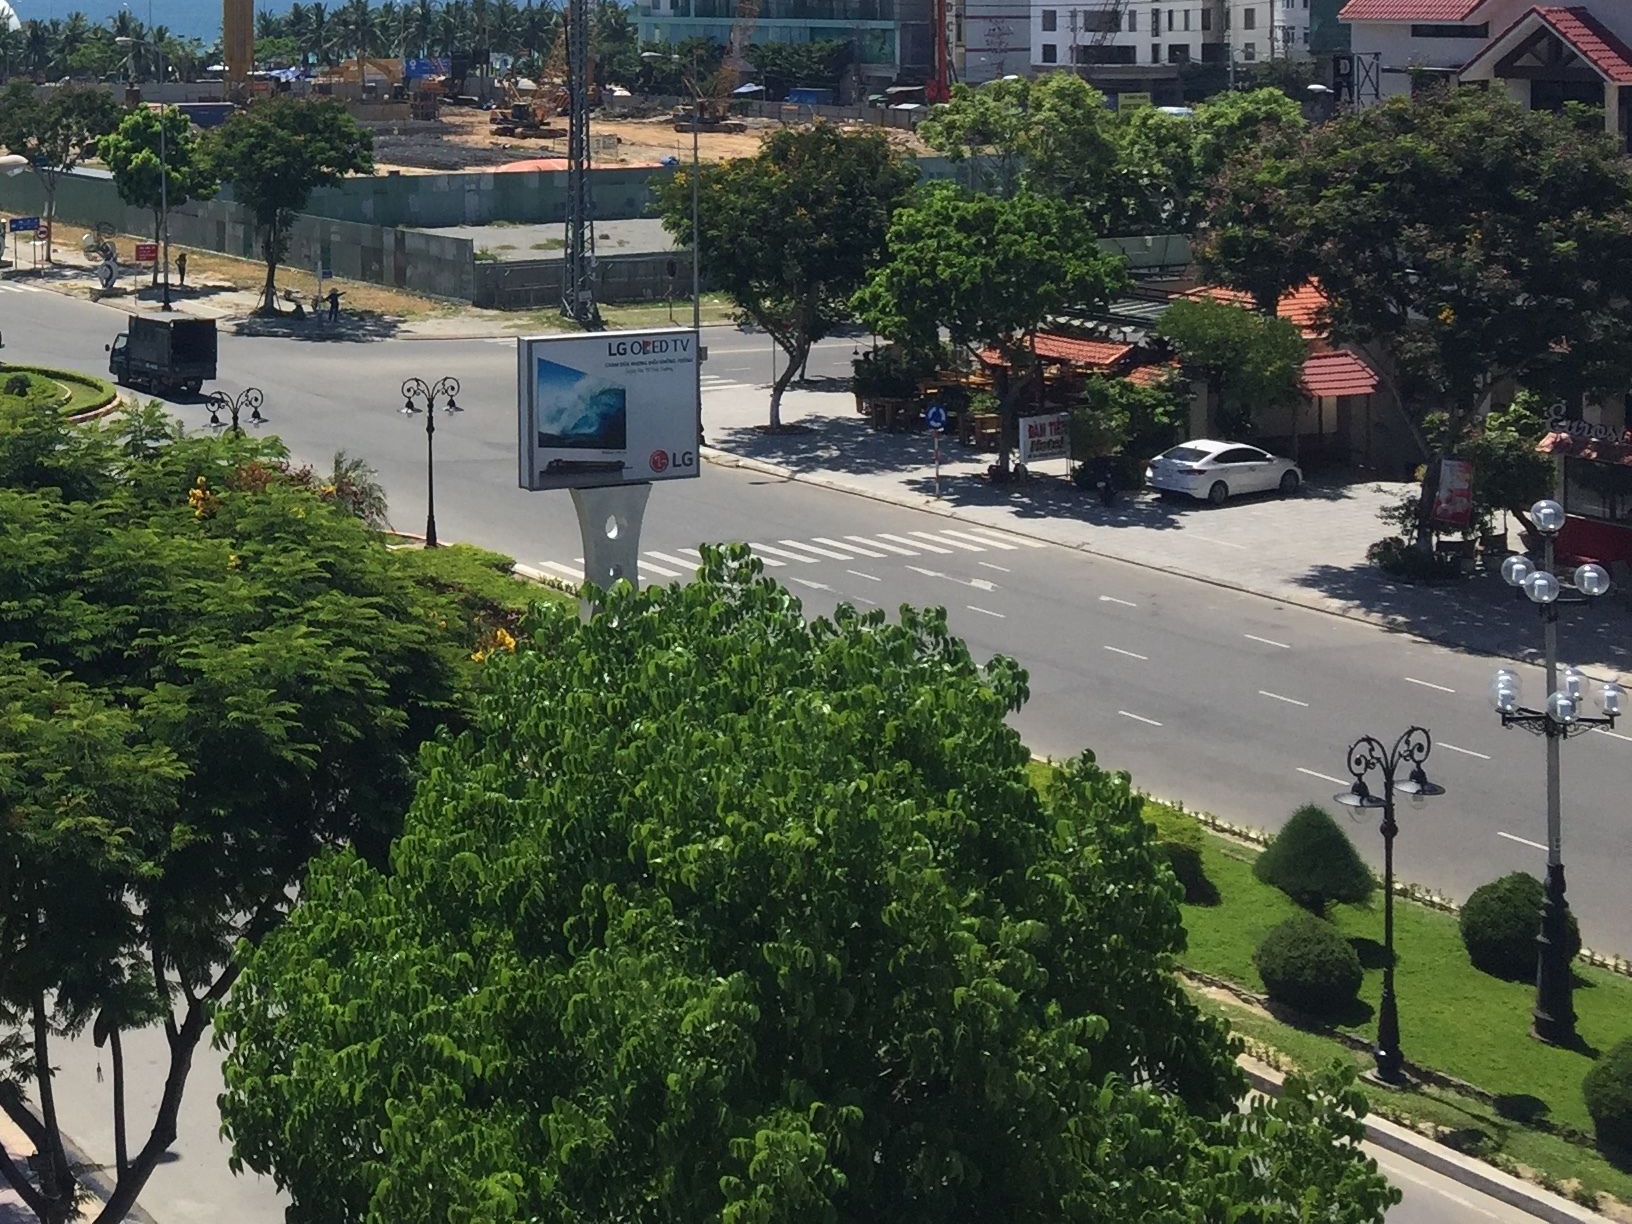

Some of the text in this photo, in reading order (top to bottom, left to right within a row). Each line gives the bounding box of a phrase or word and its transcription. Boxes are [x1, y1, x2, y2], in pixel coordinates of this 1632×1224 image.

[608, 338, 690, 357] LG OLED TV
[672, 451, 694, 468] LG
